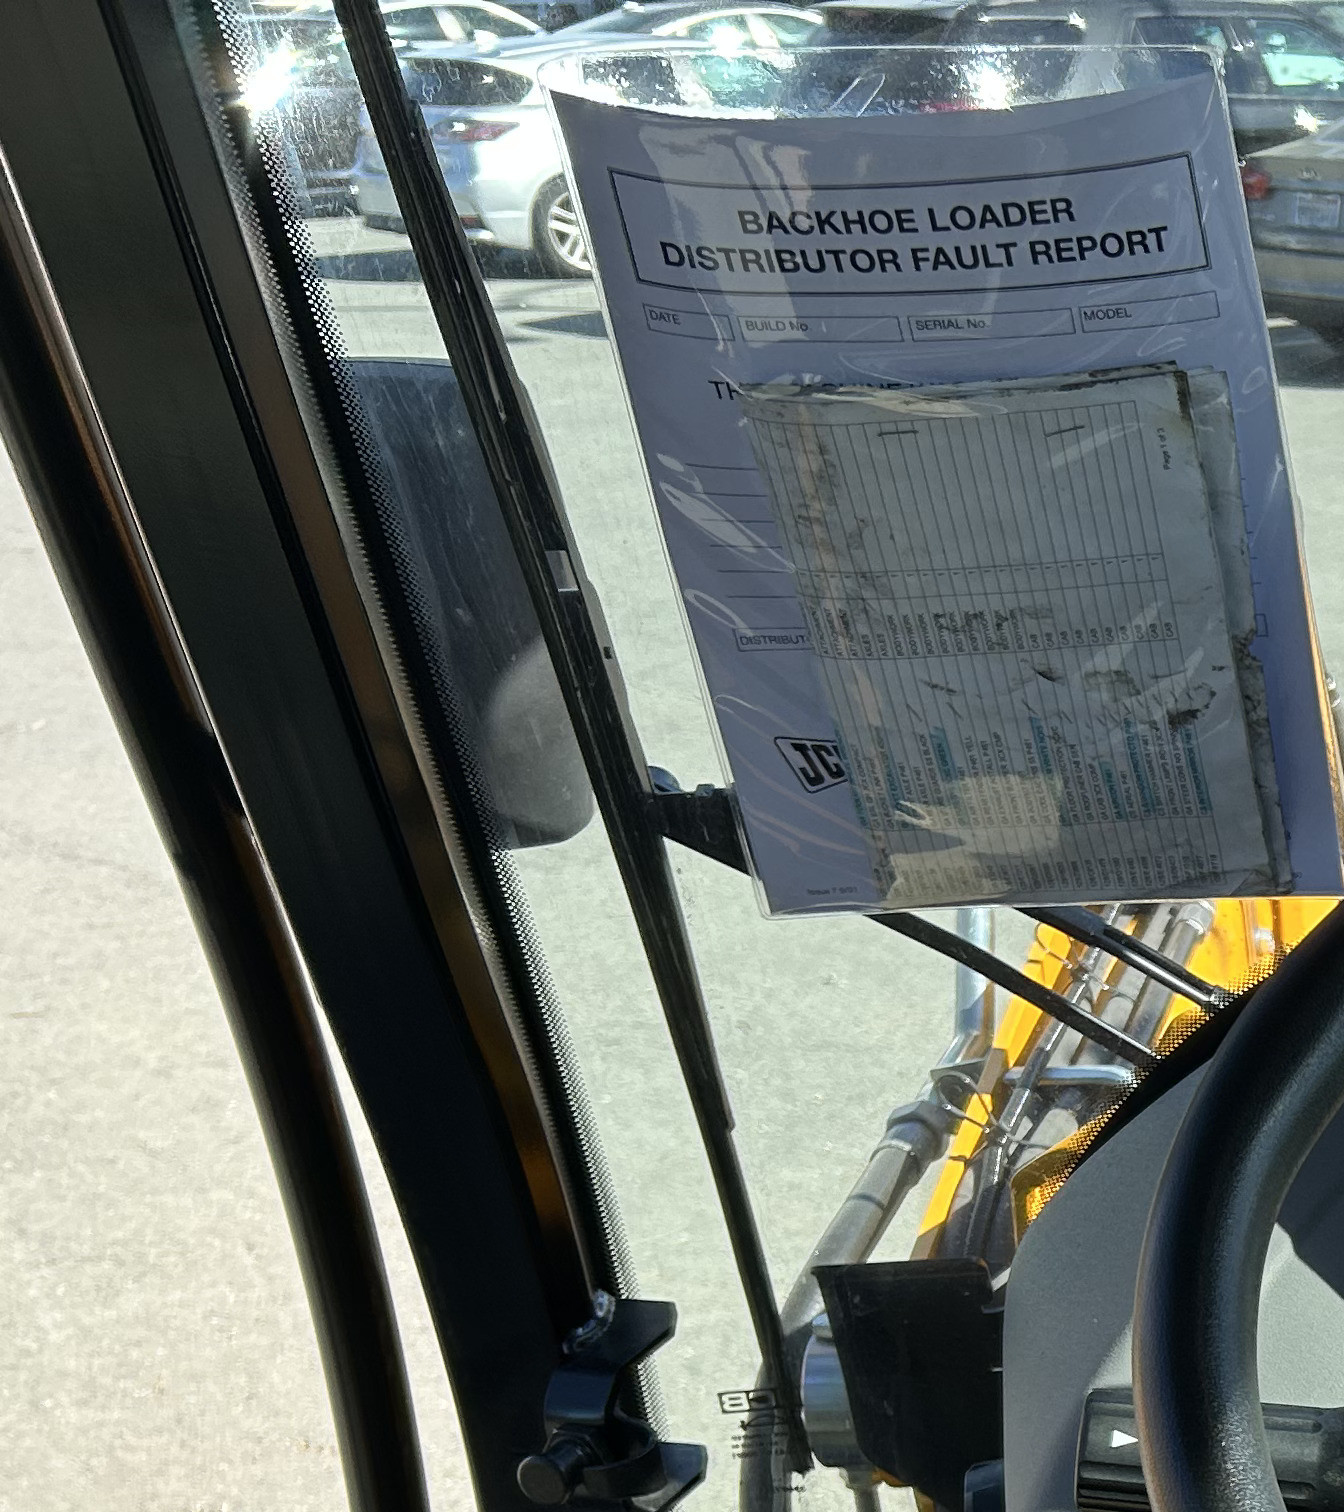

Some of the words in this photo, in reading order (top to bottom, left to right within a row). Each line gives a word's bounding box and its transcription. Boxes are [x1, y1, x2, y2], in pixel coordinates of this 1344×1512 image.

[737, 208, 919, 235] BACKHOE
[928, 197, 1076, 233] LOADER
[660, 241, 903, 274] DISTRIBUTOR
[911, 242, 1017, 272] FAULT
[1029, 226, 1168, 265] REPORT
[649, 309, 681, 326] DATE
[1082, 306, 1132, 321] MODEL
[745, 320, 786, 332] BUILD
[915, 318, 964, 331] SERIAL
[886, 614, 904, 655] BODYWORK
[902, 614, 919, 655] BODYWORK
[916, 612, 934, 654] BODYWORK
[1059, 630, 1069, 644] CAB
[1074, 629, 1084, 644] CAB
[1089, 628, 1099, 642] CAB
[1104, 626, 1114, 641] CAB
[1119, 625, 1129, 640] CAB
[1133, 624, 1144, 639] CAB
[1148, 623, 1159, 638] CAB
[1163, 622, 1174, 637] CAB
[739, 634, 806, 646] DISTRIBUT
[876, 633, 889, 656] AXLES
[1029, 634, 1039, 648] CAB
[790, 743, 845, 787] JC
[1054, 746, 1071, 788] PROTECTION
[1065, 790, 1076, 811] FLOOR
